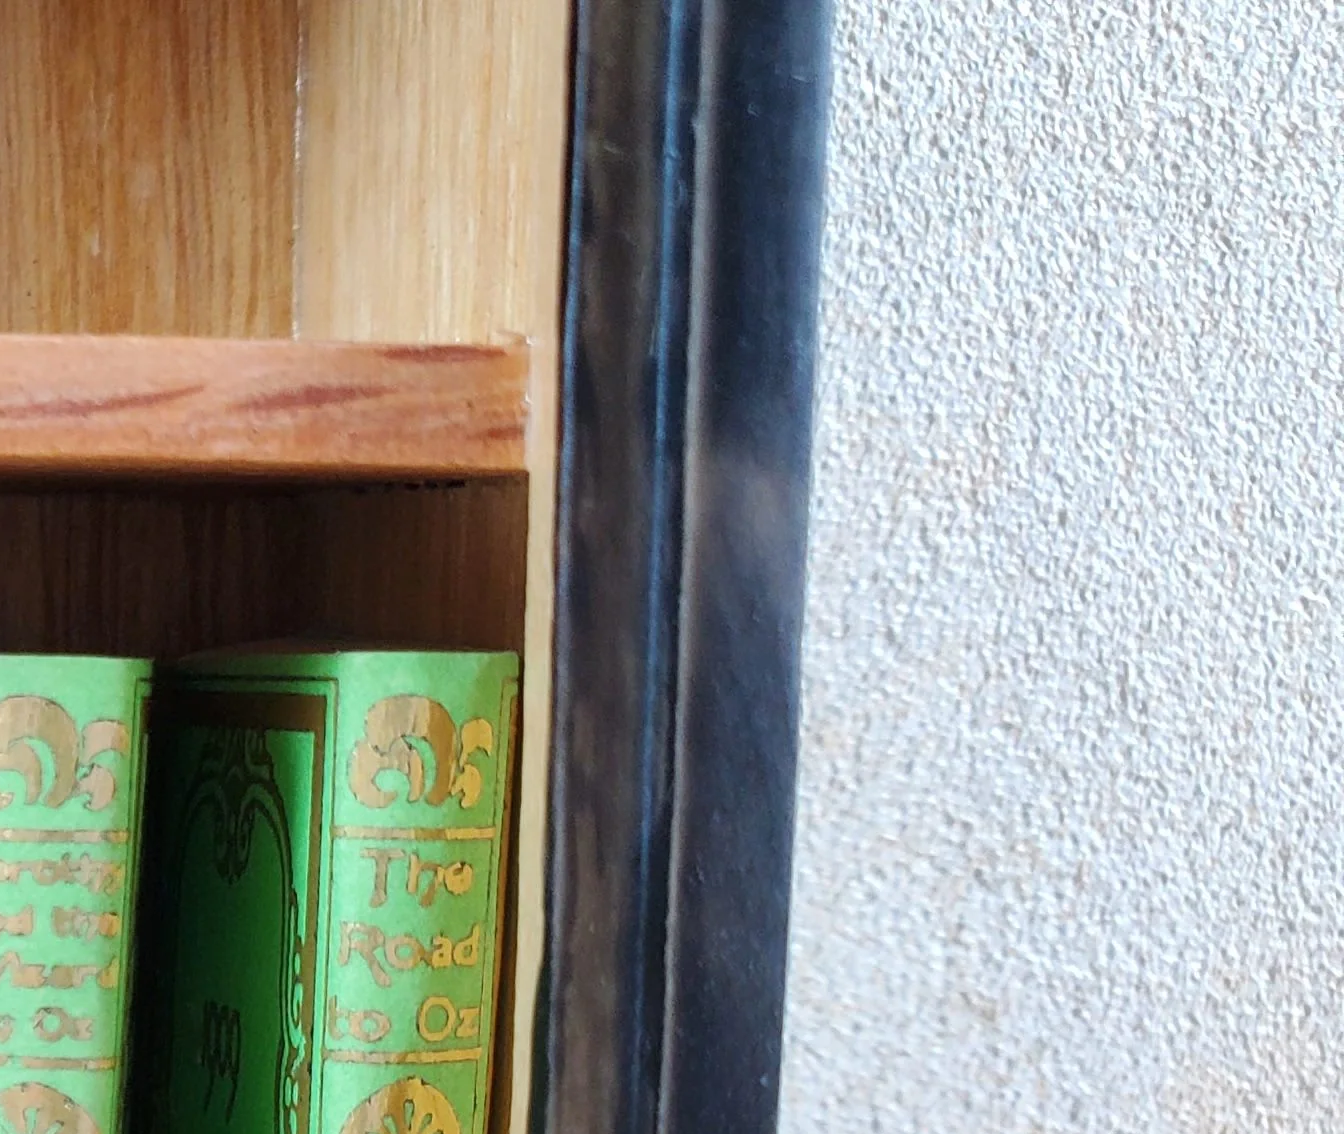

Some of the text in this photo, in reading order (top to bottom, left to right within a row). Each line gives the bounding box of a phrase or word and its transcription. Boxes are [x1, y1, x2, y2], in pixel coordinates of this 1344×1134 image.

[360, 848, 473, 908] The
[338, 921, 481, 988] Road
[32, 1005, 95, 1043] Oz
[326, 990, 482, 1043] to Oz
